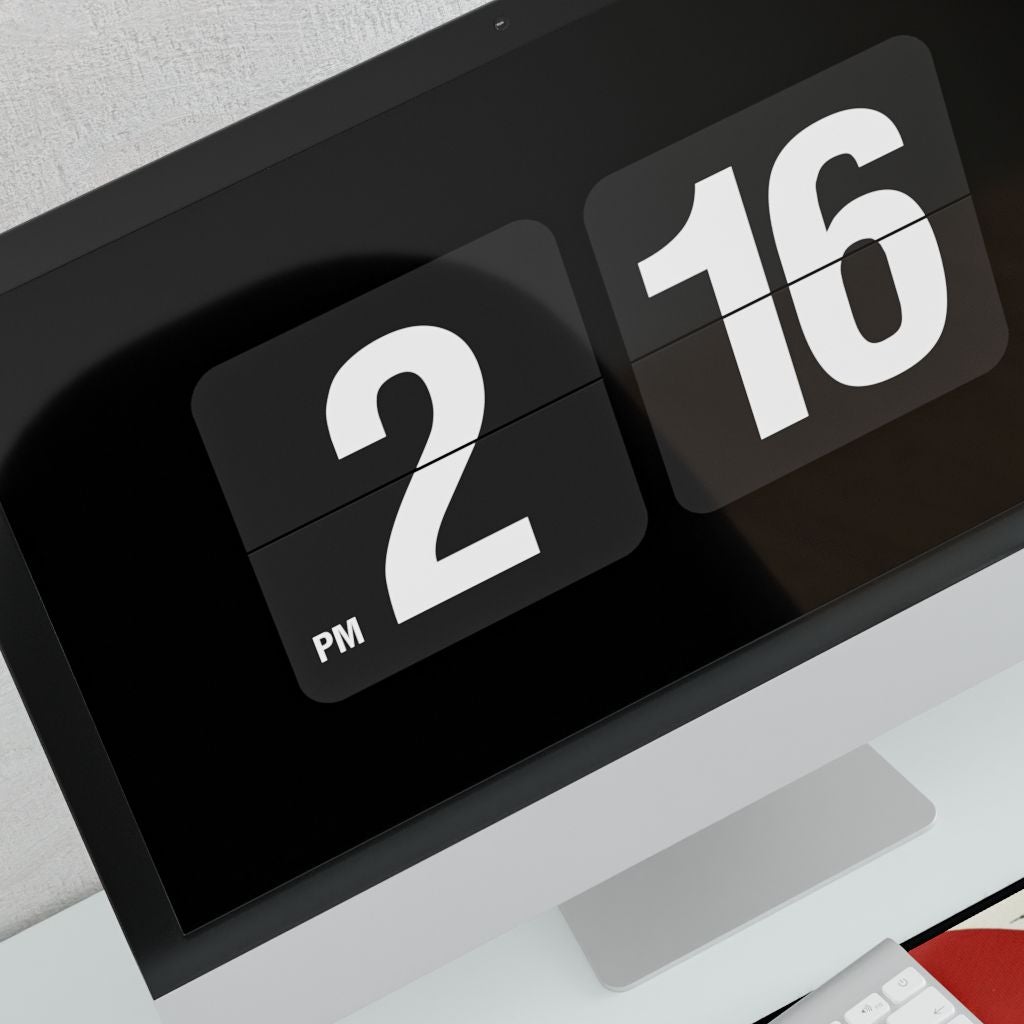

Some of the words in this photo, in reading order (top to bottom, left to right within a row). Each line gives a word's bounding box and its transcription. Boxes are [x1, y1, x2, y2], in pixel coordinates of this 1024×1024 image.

[326, 326, 540, 624] 2
[638, 108, 947, 439] 16
[312, 616, 365, 664] PM
